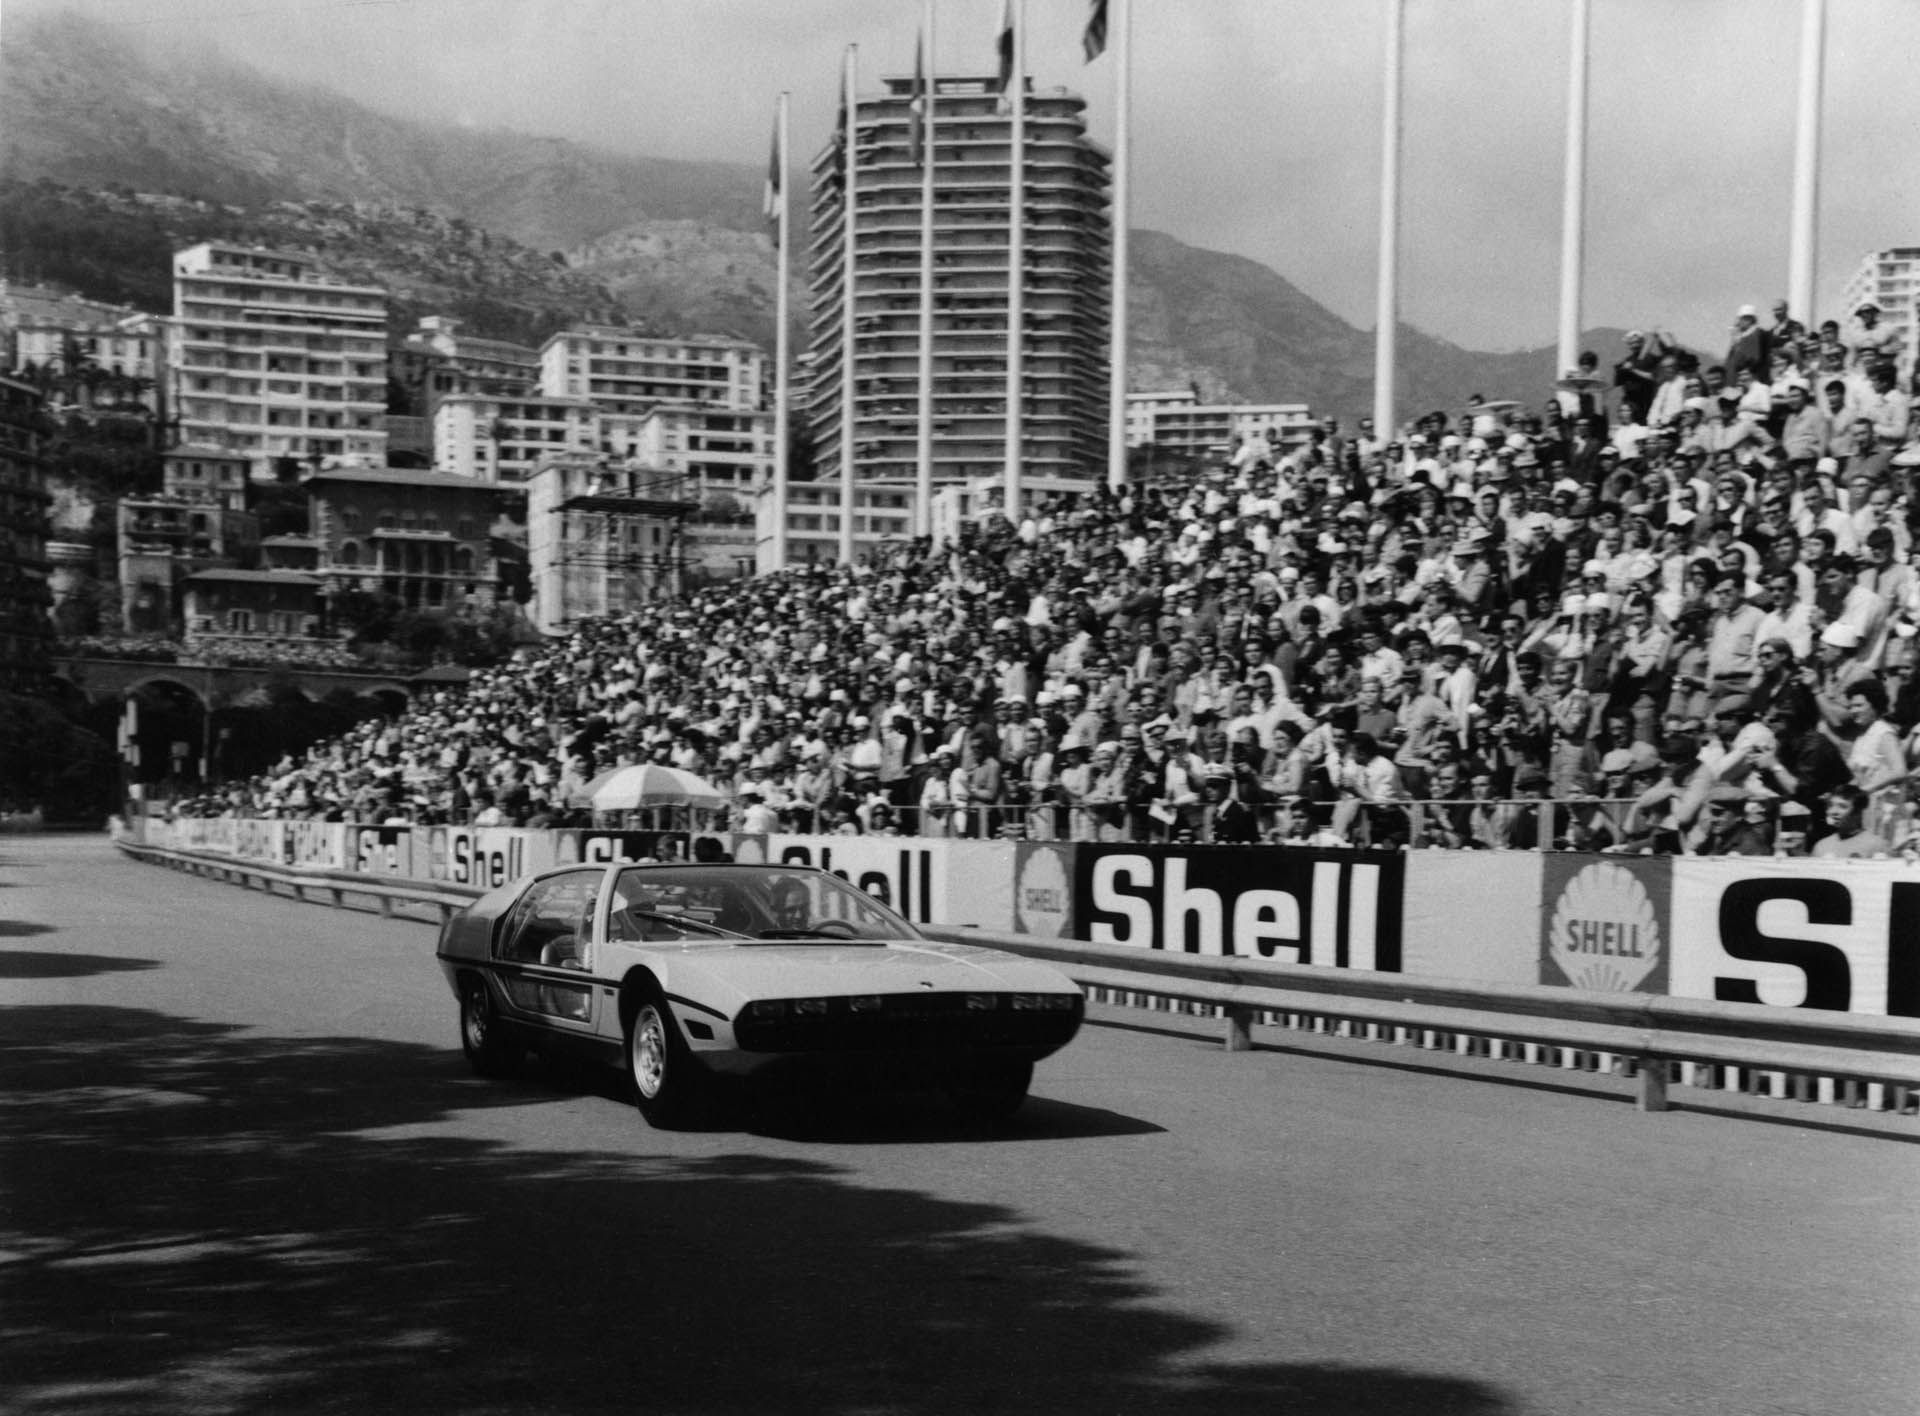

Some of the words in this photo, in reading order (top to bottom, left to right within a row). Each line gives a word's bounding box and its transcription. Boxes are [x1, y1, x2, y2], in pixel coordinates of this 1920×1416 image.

[455, 834, 523, 888] Shell
[1090, 854, 1380, 971] Shell
[1567, 918, 1644, 958] SHELL
[1714, 877, 1920, 1018] S
